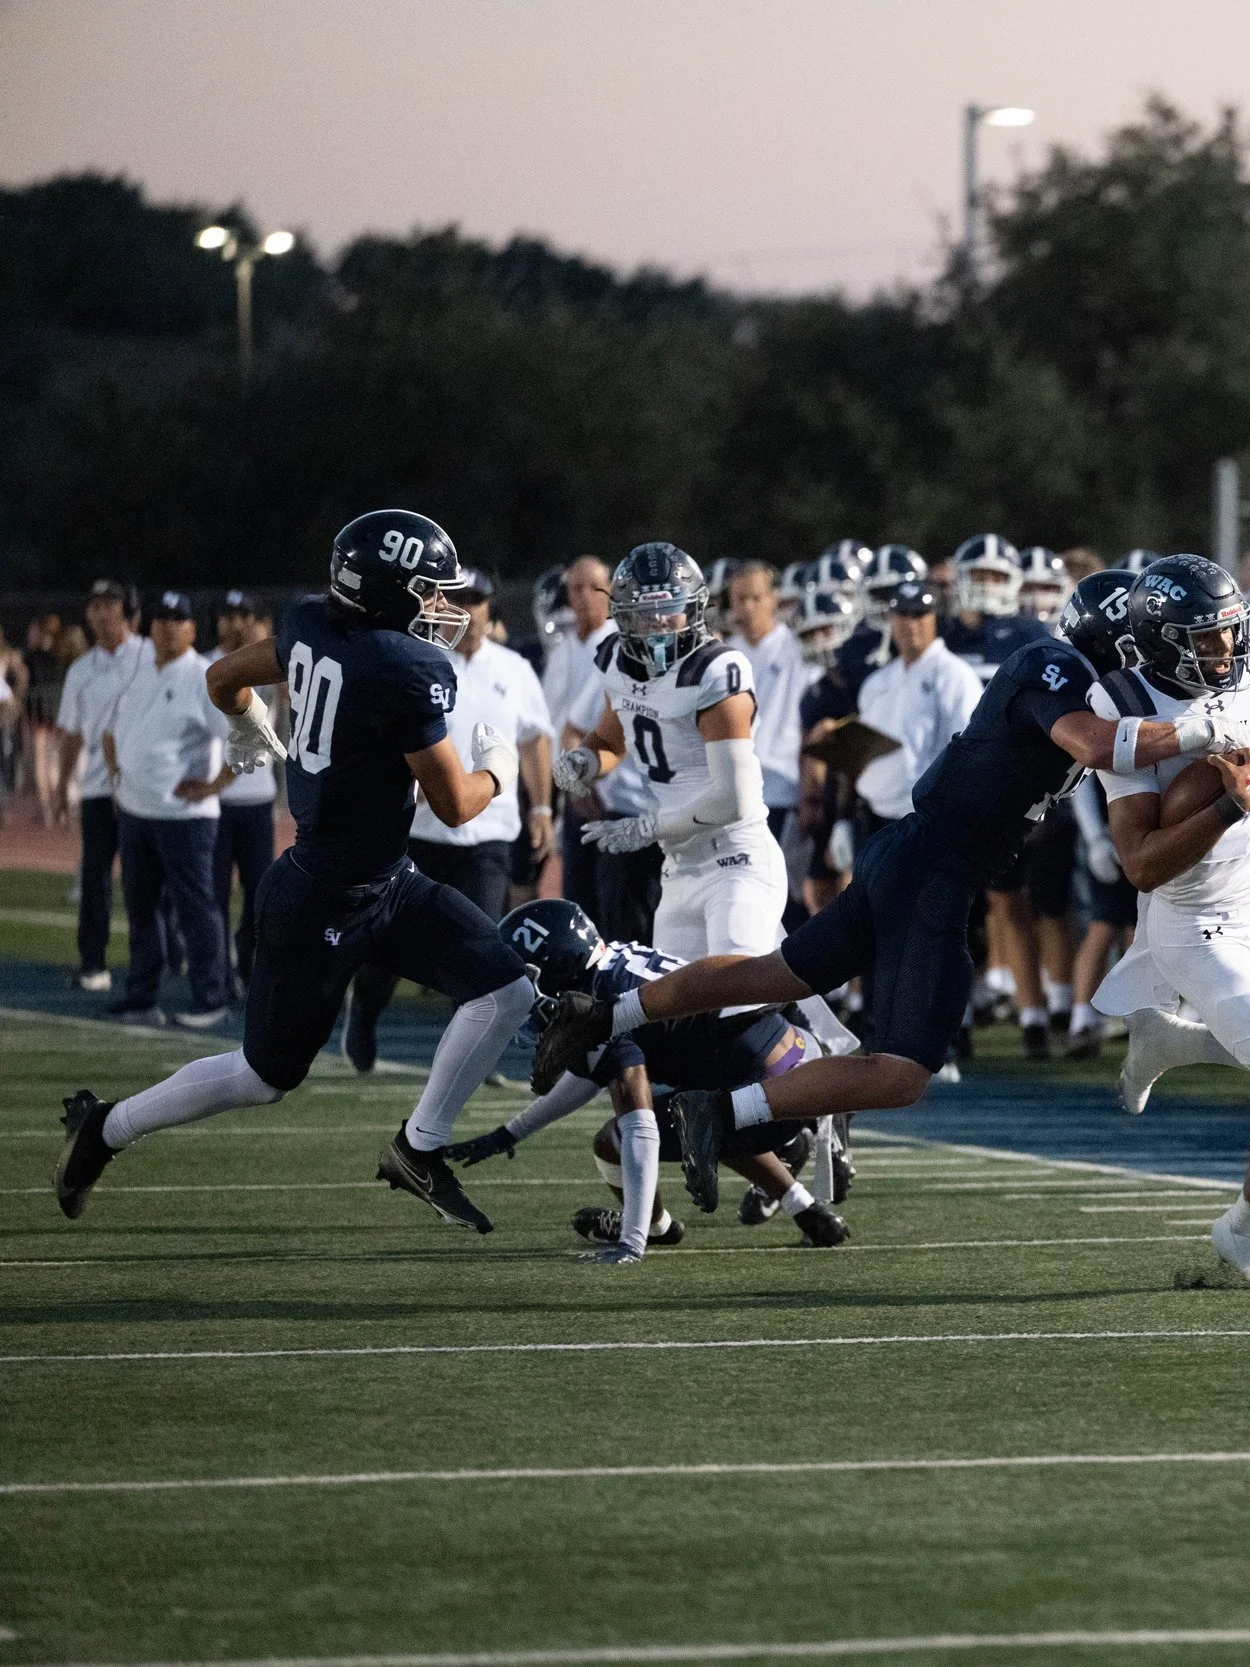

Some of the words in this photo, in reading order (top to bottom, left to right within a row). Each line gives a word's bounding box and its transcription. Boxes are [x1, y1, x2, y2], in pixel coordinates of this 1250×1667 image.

[379, 530, 424, 570] 90
[1144, 575, 1188, 601] WAC
[1099, 587, 1130, 622] 15
[726, 662, 740, 694] 0
[1042, 663, 1068, 691] SV
[288, 641, 343, 775] 90
[429, 683, 450, 709] SV
[621, 698, 659, 719] CHAMPION
[633, 714, 676, 784] 0
[323, 928, 341, 945] SV
[513, 918, 550, 953] 21
